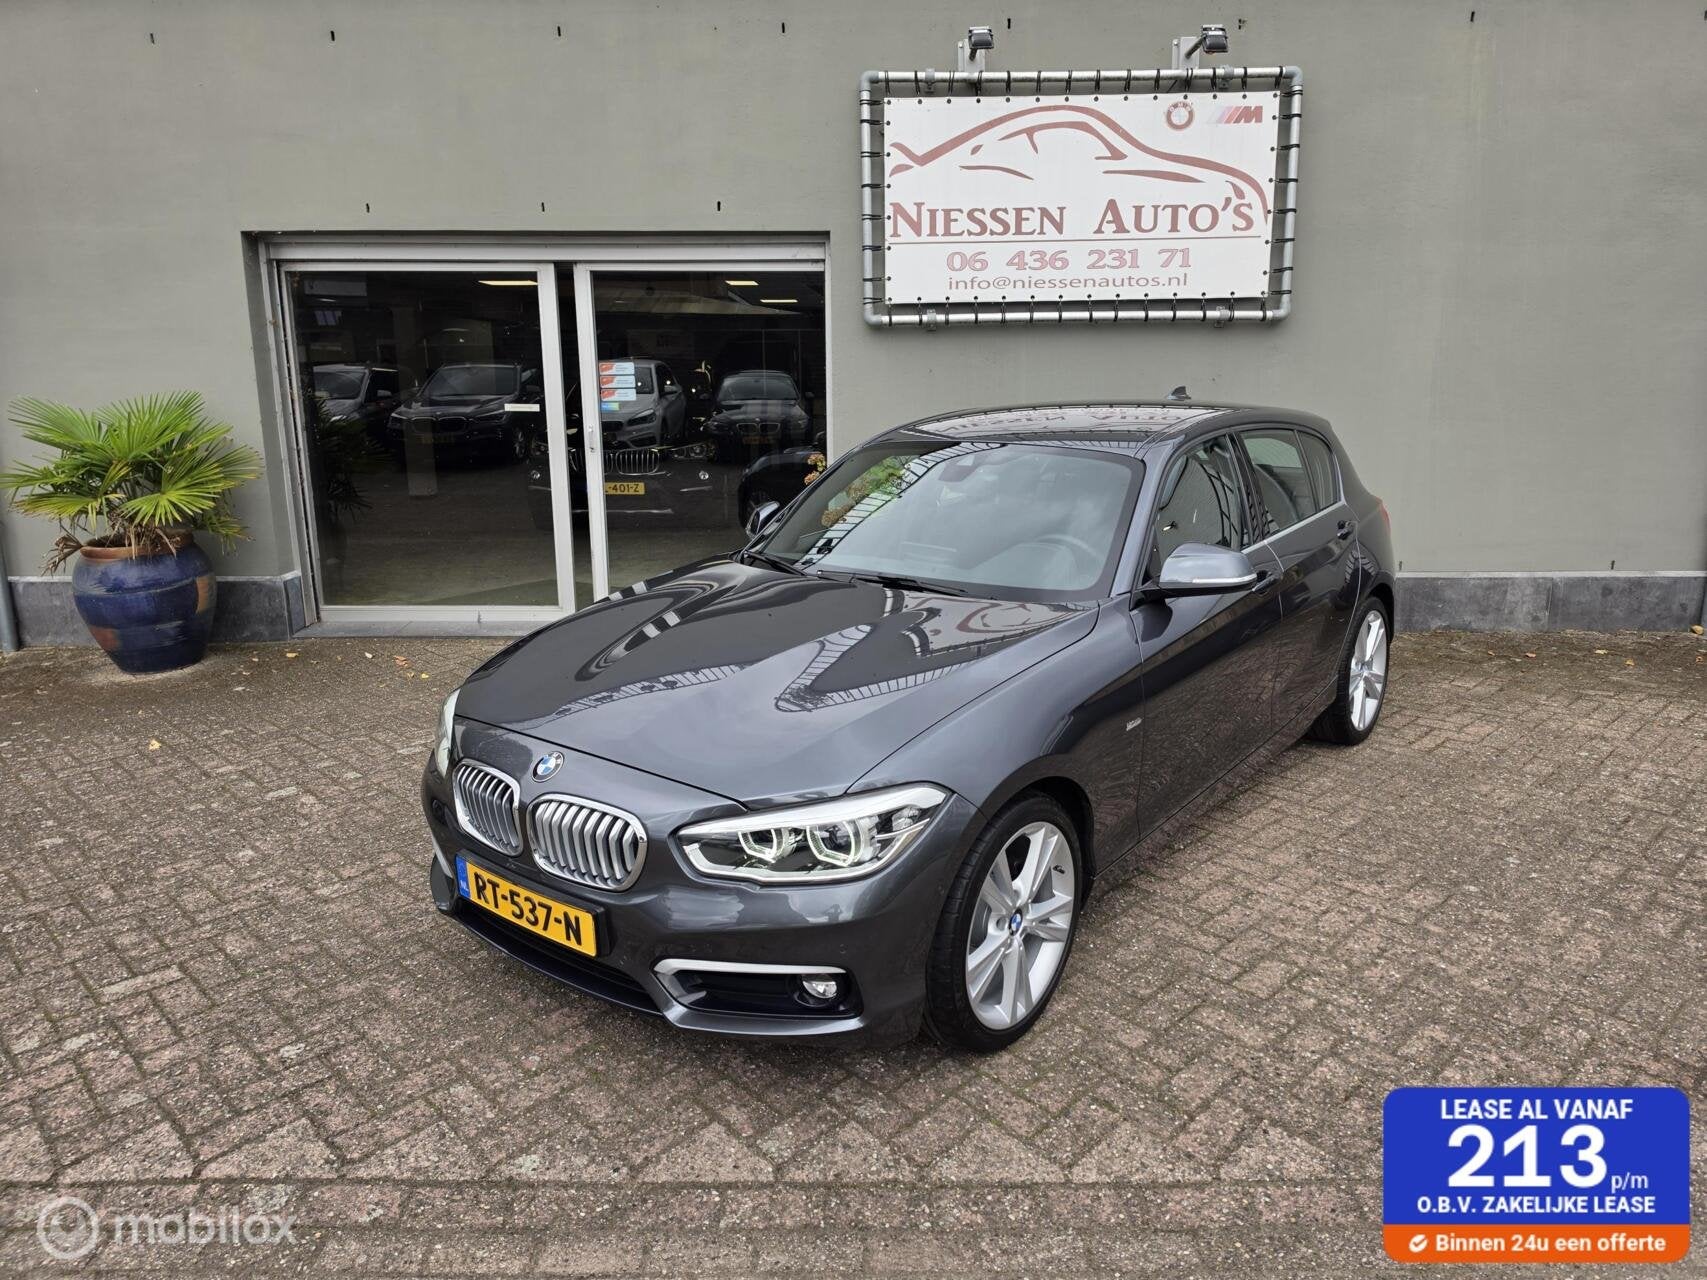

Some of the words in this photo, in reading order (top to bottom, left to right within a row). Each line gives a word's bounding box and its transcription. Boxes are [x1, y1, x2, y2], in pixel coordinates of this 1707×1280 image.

[890, 202, 1066, 238] NIESSEN
[1093, 197, 1255, 235] AUTO'S
[946, 250, 989, 272] 06
[1006, 249, 1070, 272] 436
[1086, 248, 1140, 270] 231
[1158, 246, 1192, 269] 71
[947, 272, 1189, 292] info@niessenautos.nl
[605, 483, 640, 493] -401-Z
[474, 872, 582, 946] RT-537-N
